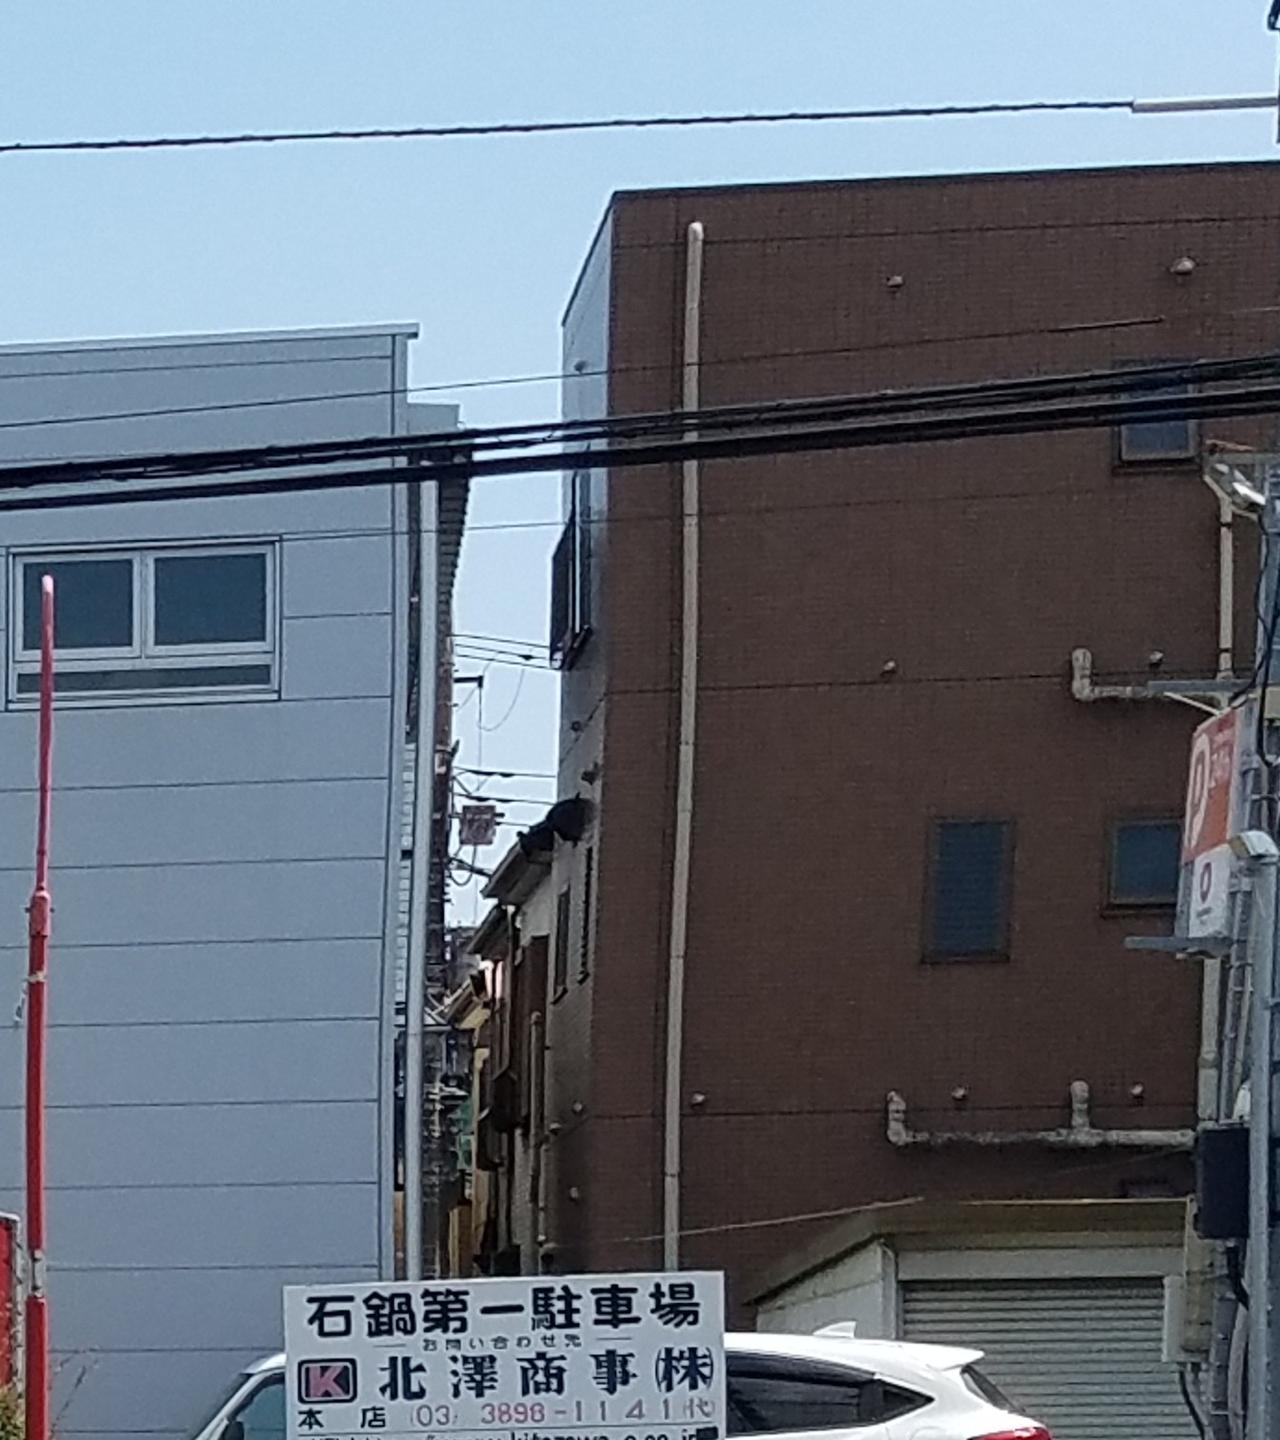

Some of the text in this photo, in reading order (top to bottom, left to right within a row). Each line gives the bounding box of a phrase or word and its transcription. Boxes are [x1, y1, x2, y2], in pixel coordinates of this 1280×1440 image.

[306, 1282, 700, 1338] 石鍋第一駐車場
